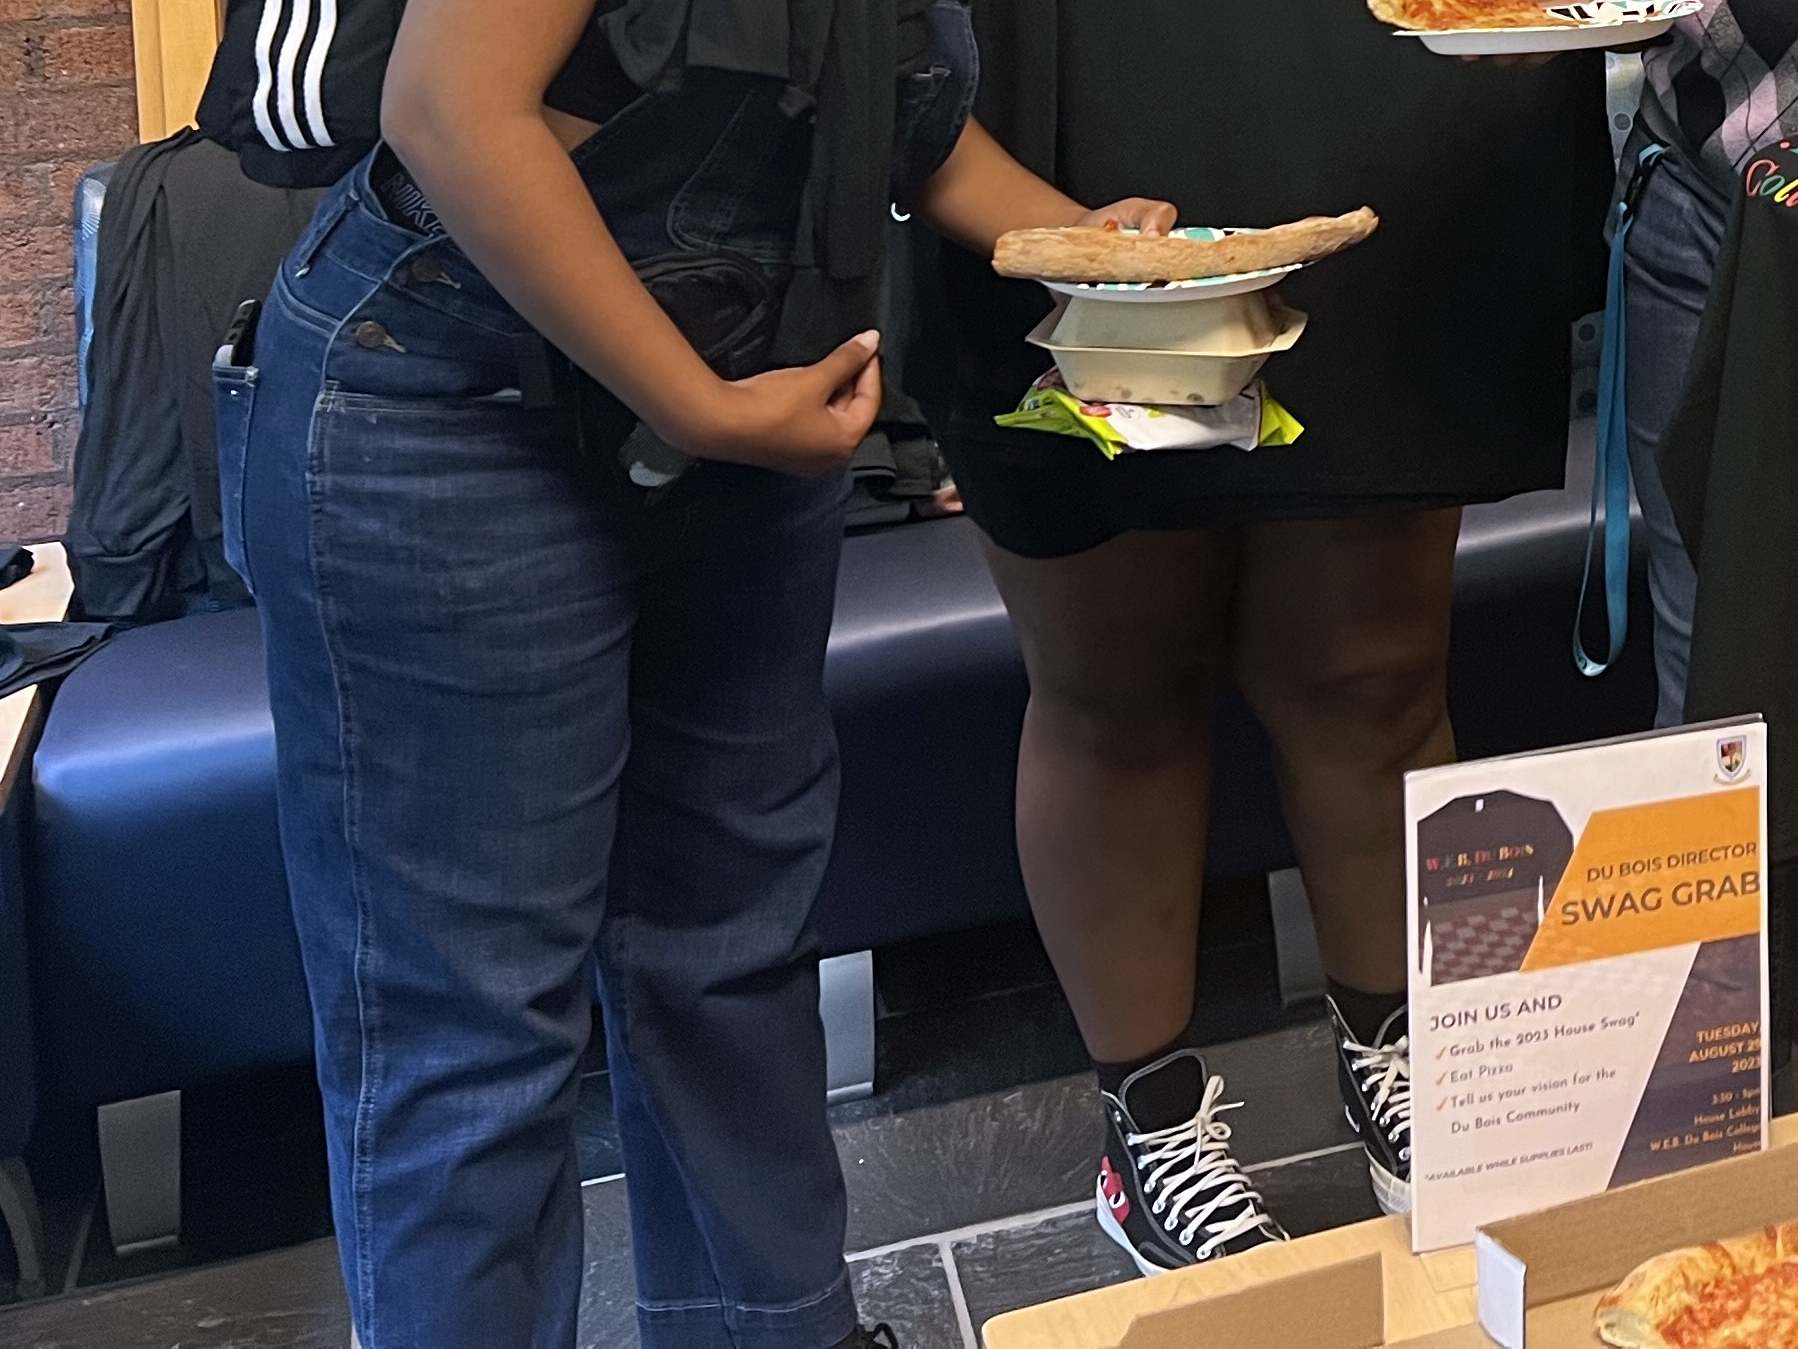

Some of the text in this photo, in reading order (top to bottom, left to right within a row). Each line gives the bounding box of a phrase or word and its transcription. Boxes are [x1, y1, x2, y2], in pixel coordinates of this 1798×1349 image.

[1587, 841, 1757, 883] DU BOIS DIRECTOR
[1561, 870, 1761, 926] SWAG GRAB
[1430, 993, 1563, 1032] JOIN US AND
[1449, 1034, 1485, 1058] Grab
[1489, 1035, 1512, 1050] the
[1516, 1028, 1550, 1046] 2023
[1554, 1022, 1596, 1038] House
[1696, 1020, 1760, 1044] TUESDAY
[1688, 1040, 1744, 1063] AUGUST
[1450, 1063, 1514, 1084] Eat Pizza
[1451, 1066, 1617, 1109] Tell us your vision for the
[1451, 1101, 1581, 1135] Du Bois Community
[1683, 1132, 1700, 1146] Du
[1702, 1129, 1724, 1142] Bois
[1485, 1157, 1518, 1172] WHILE
[1519, 1149, 1566, 1165] SUPPLIES
